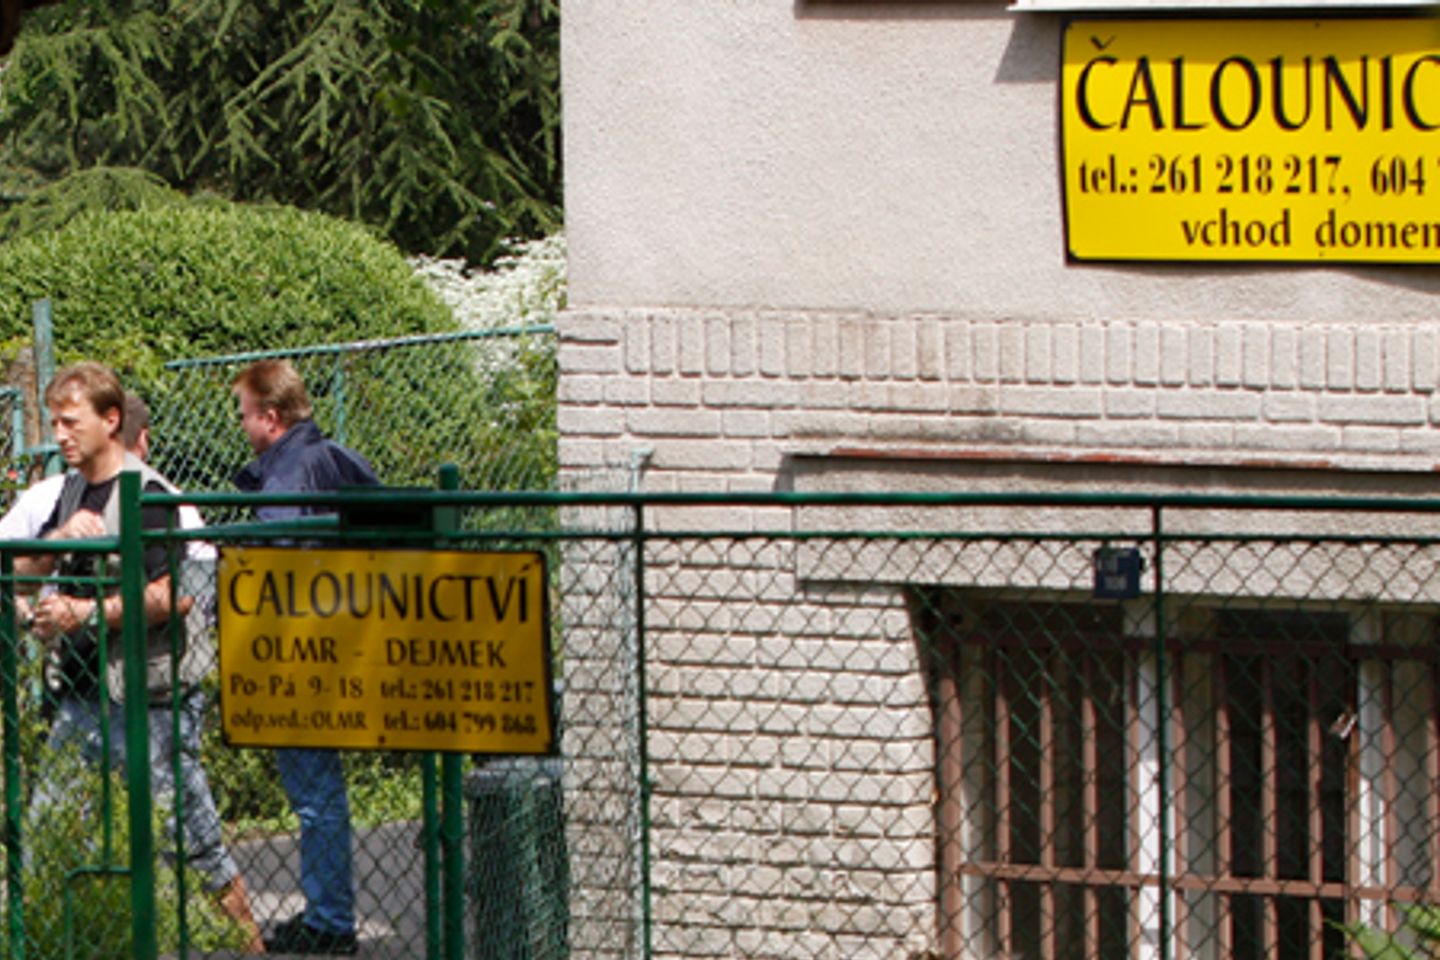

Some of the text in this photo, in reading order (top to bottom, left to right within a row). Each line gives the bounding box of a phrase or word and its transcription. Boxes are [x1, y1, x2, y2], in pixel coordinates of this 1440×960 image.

[1079, 154, 1426, 204] tel.: 261 218 217, 604
[1182, 207, 1291, 248] vchod
[229, 557, 529, 623] ČALOUNICTVÍ
[252, 636, 338, 664] OLMR
[386, 637, 506, 668] DEJMEK
